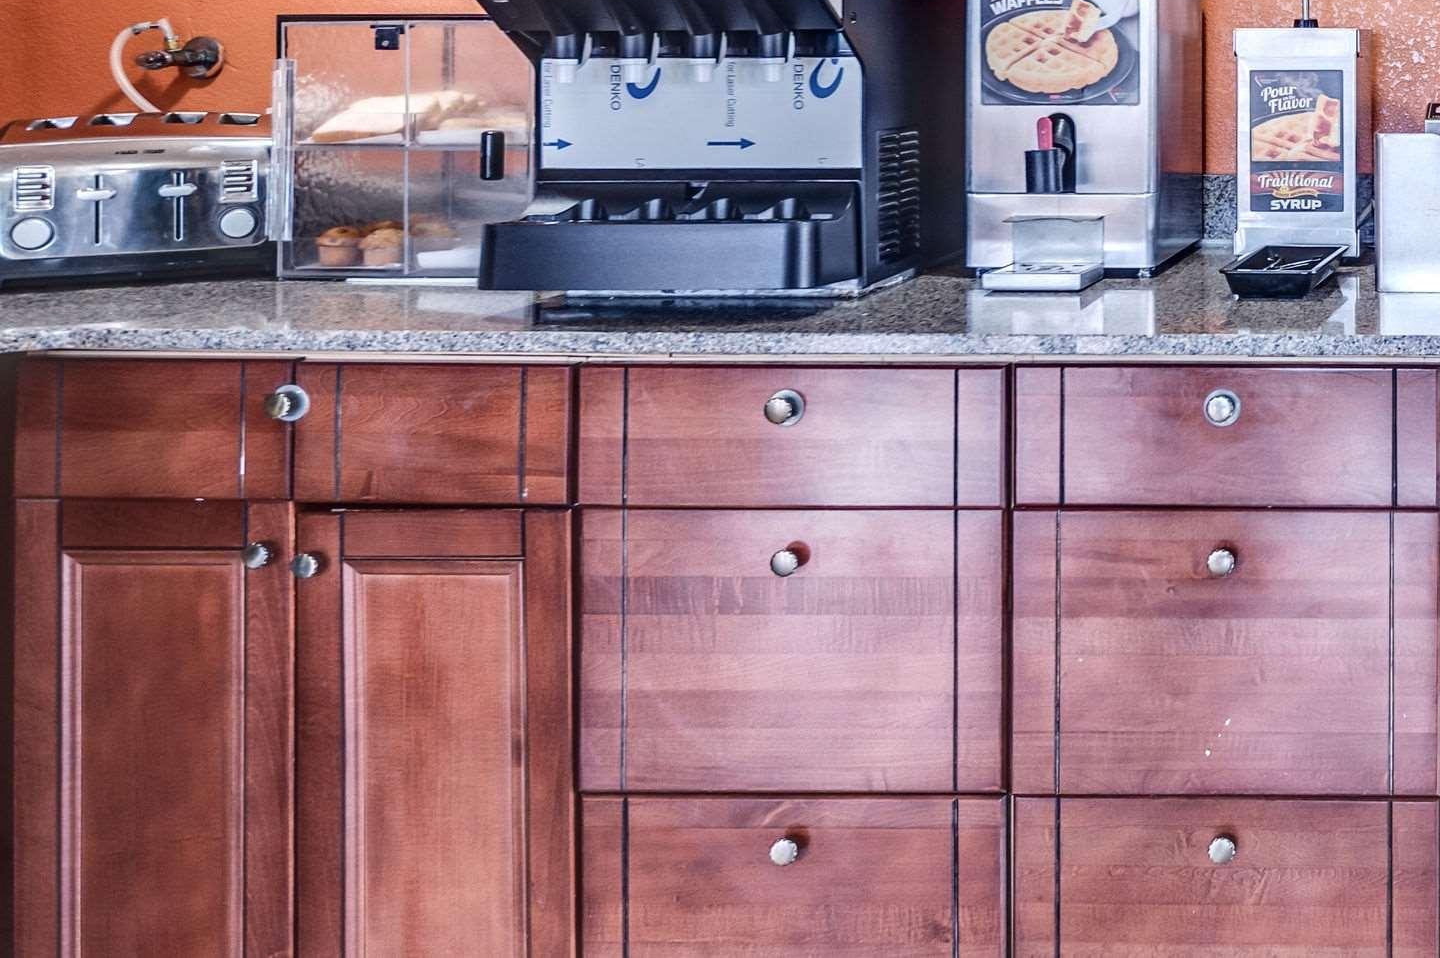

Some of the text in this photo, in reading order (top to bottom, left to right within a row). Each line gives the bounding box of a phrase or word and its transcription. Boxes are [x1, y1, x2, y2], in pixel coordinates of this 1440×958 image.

[610, 64, 622, 111] DENKO
[793, 64, 804, 110] DENKO
[1261, 86, 1296, 102] Pour
[1268, 97, 1313, 113] Flavor
[1258, 174, 1334, 188] Traditional
[1270, 199, 1322, 210] SYRUP
